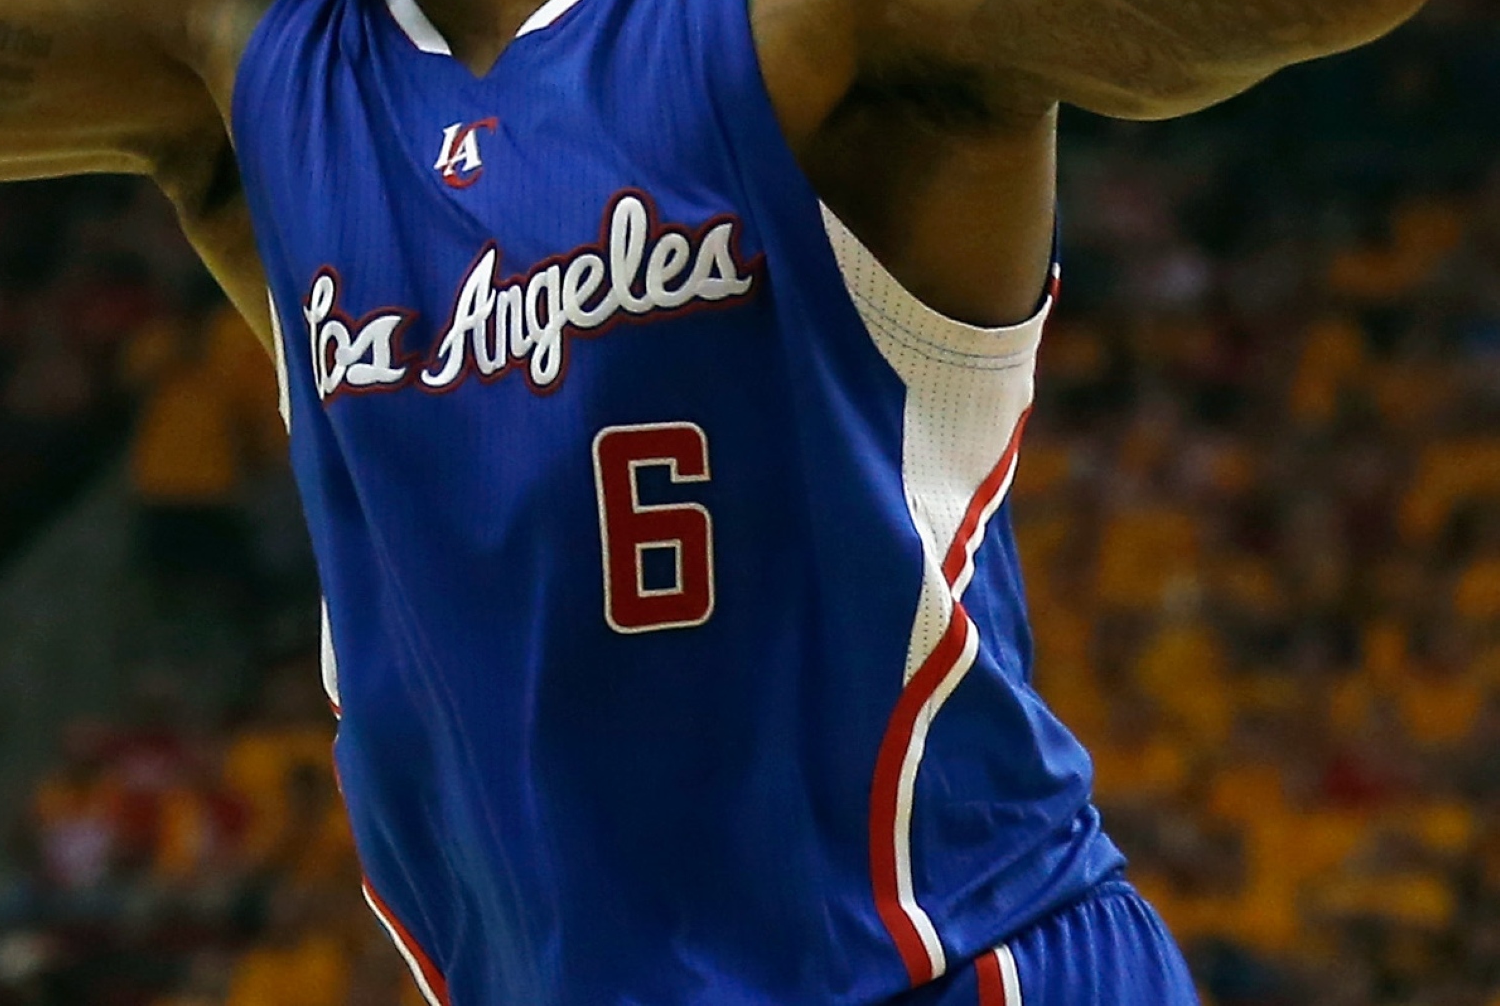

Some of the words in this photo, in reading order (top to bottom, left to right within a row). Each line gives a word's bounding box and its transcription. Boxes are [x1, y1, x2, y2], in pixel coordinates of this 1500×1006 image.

[302, 269, 412, 403] Los
[419, 190, 758, 390] Angeles
[592, 421, 714, 634] 6
